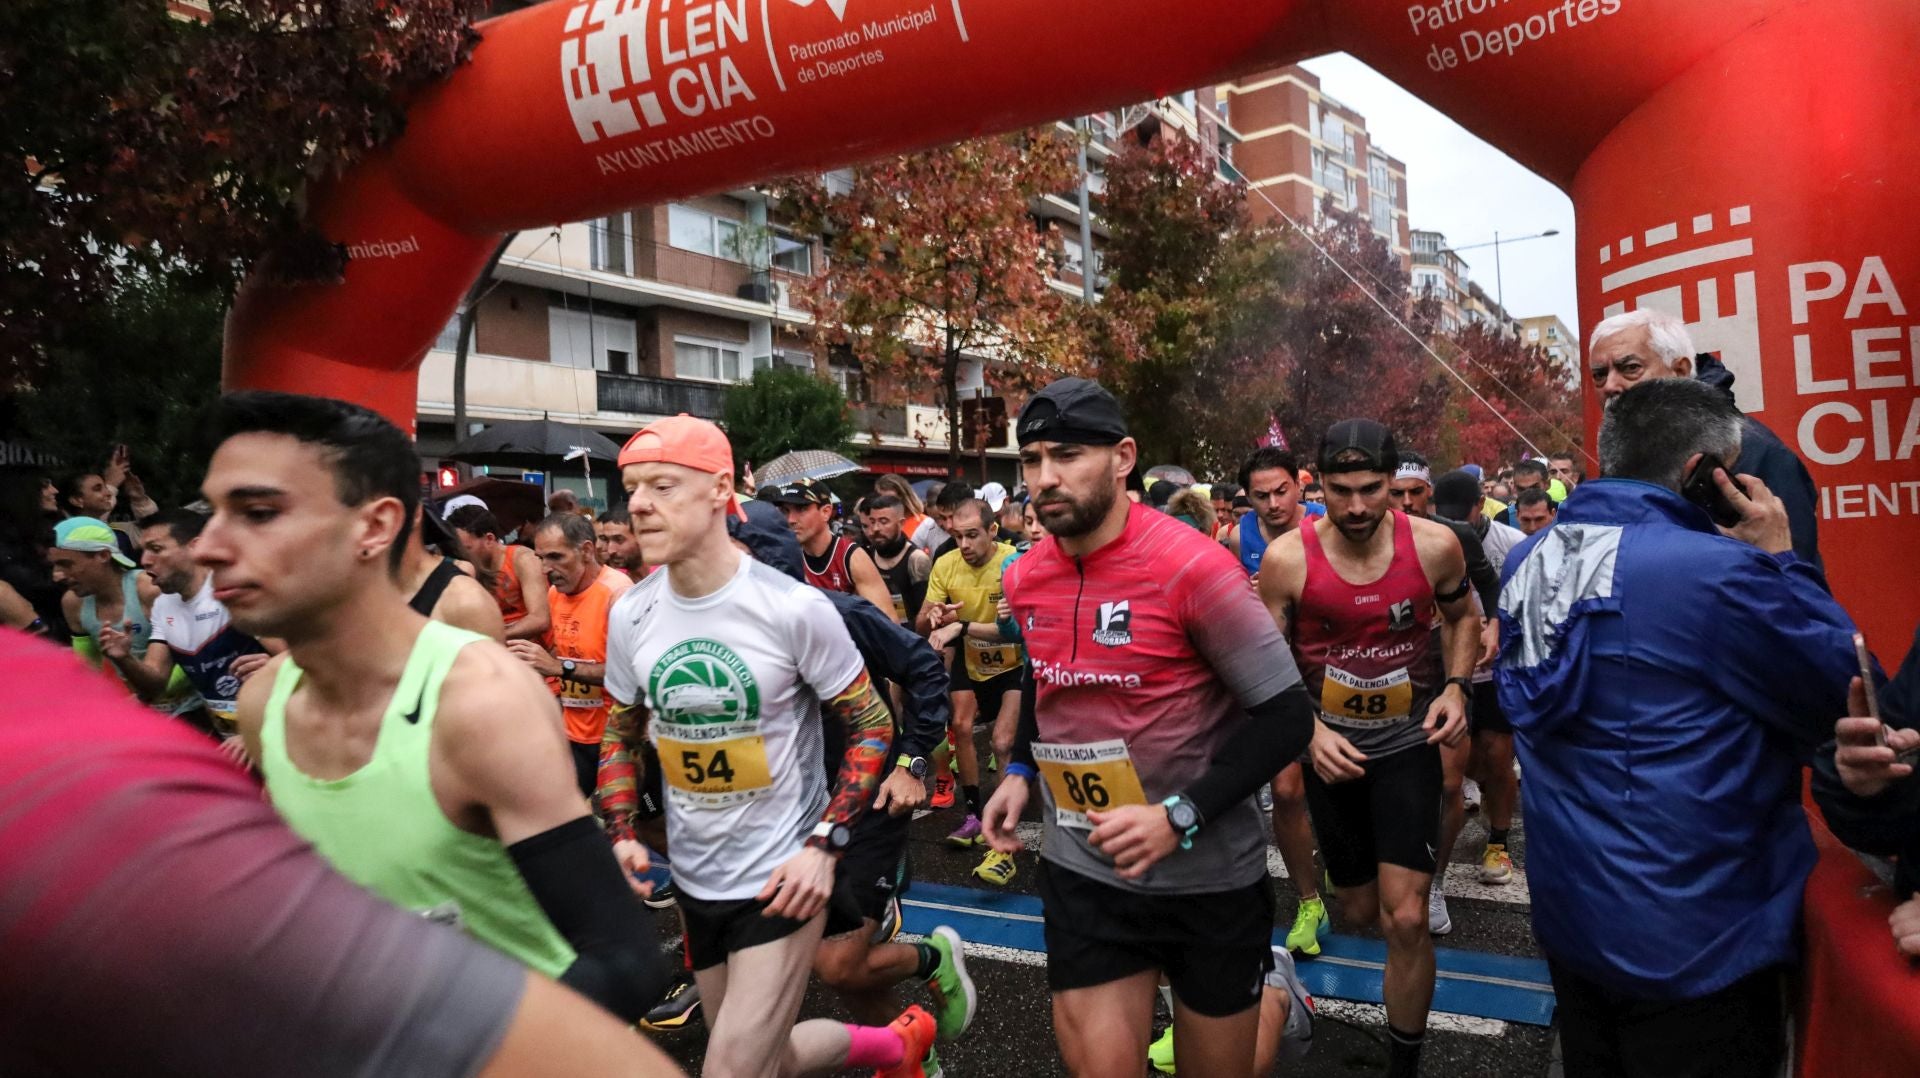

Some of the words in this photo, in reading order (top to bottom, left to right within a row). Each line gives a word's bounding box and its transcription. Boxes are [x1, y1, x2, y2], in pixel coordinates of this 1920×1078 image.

[660, 0, 749, 65] LEN
[788, 29, 861, 63] Patronato
[862, 4, 937, 43] Municipal
[1407, 0, 1498, 36] Patro
[1426, 43, 1459, 72] de
[1459, 0, 1622, 63] Deportes
[797, 63, 817, 84] de
[816, 46, 885, 80] Deportes
[668, 55, 757, 118] CIA
[595, 114, 776, 176] AYUNTAMIENTO
[346, 234, 420, 260] nicipal
[1788, 255, 1907, 325] PA
[1793, 324, 1920, 396] LE
[1820, 480, 1920, 521] IENT
[662, 644, 691, 667] TRAIL
[691, 641, 755, 689] VALLEJUELOS
[980, 650, 1004, 665] 84
[1349, 677, 1390, 689] PALENCIA
[1343, 694, 1387, 715] 48
[677, 725, 728, 742] PALENCIA
[681, 749, 735, 785] 54
[1053, 745, 1098, 761] PALENCIA
[1062, 770, 1110, 808] 86
